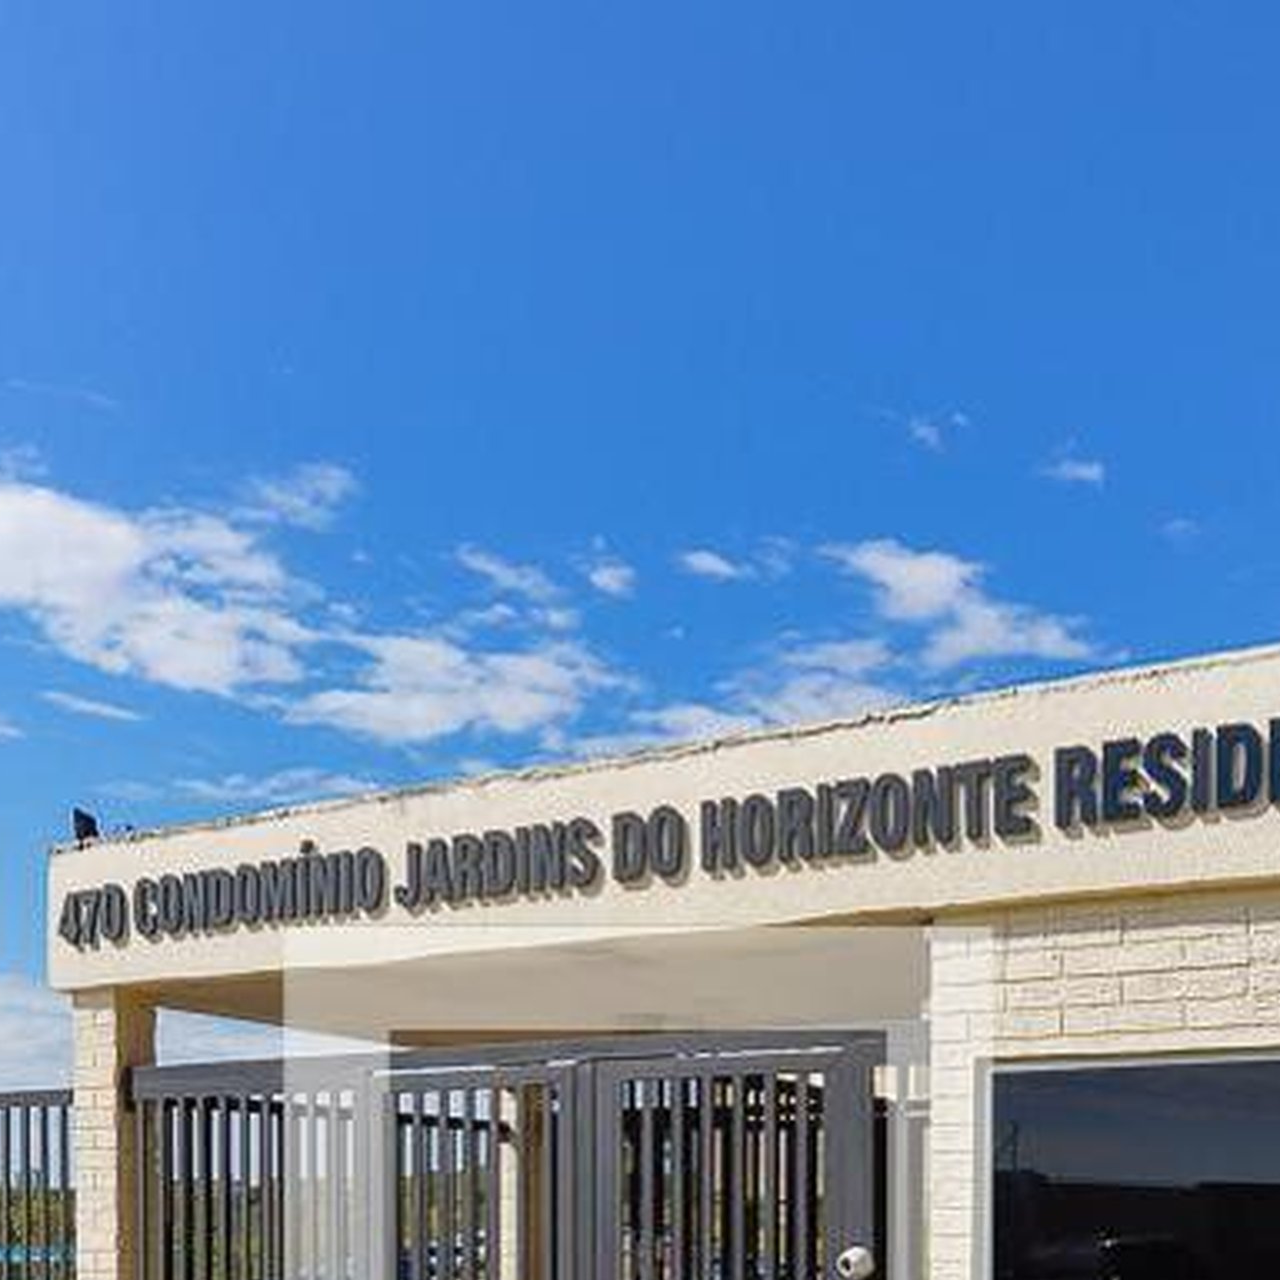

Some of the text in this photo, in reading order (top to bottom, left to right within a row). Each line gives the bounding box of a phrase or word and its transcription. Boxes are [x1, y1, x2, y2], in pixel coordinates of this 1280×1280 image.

[60, 884, 127, 944] 470
[395, 817, 604, 908] JARDINS
[612, 806, 686, 882] DO
[701, 755, 1036, 873] HORIZONTE
